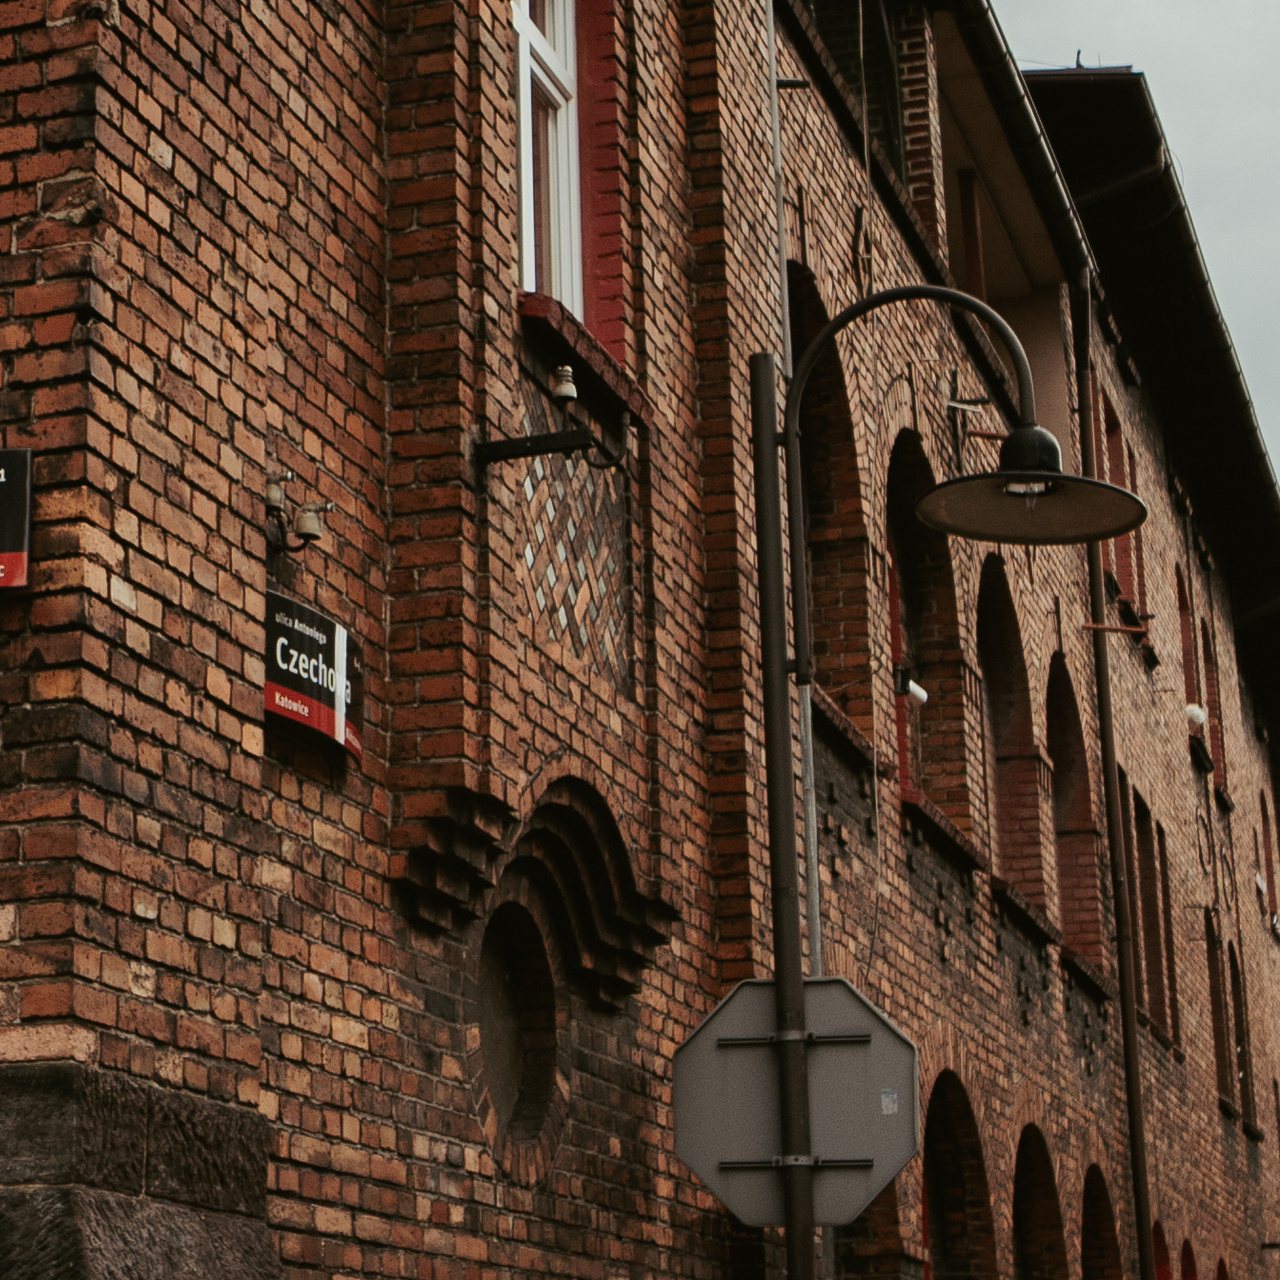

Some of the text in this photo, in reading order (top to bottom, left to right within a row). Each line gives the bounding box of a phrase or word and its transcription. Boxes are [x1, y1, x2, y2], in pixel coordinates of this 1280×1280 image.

[275, 612, 293, 628] ulica
[276, 636, 352, 704] Czechoa
[274, 691, 310, 717] Katowice
